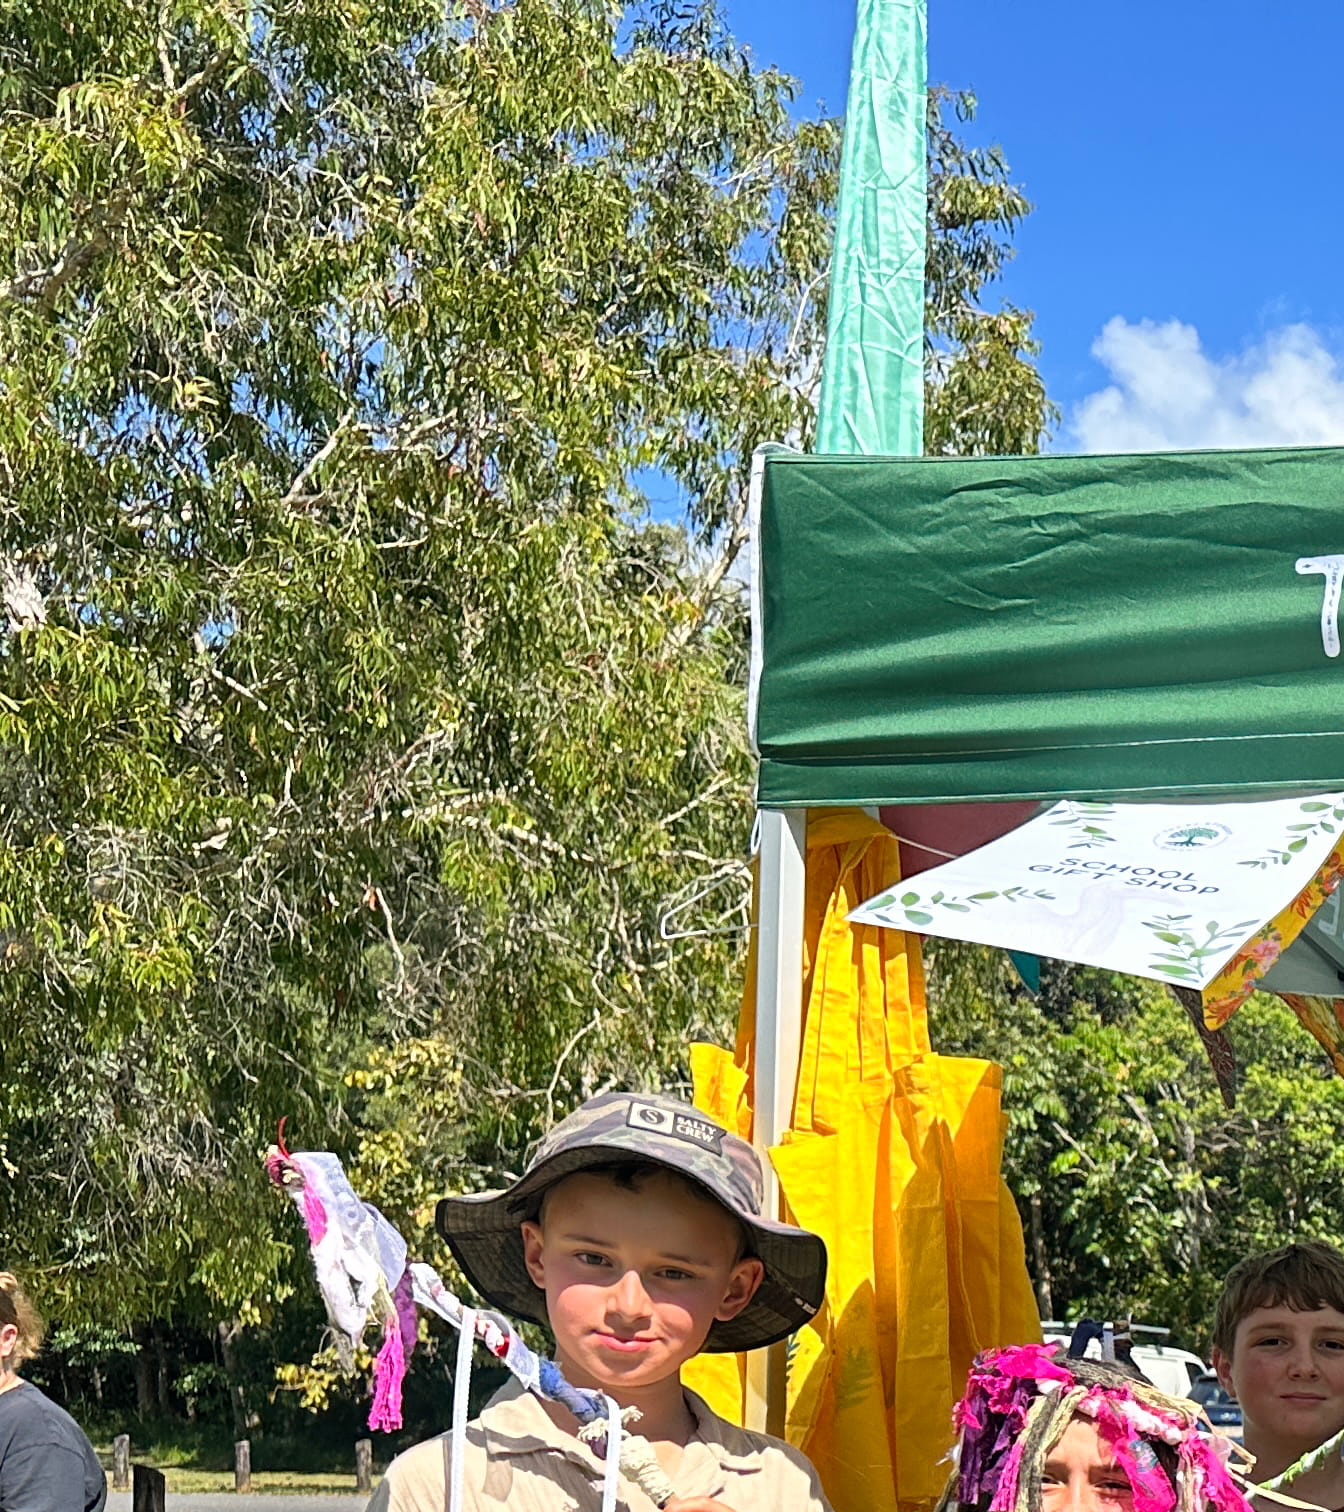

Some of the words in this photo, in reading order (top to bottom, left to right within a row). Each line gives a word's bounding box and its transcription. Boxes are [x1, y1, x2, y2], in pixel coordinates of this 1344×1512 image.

[1027, 864, 1116, 880] GIFT
[1124, 877, 1221, 895] SHOP
[1058, 857, 1198, 882] SCHOOL
[675, 1124, 714, 1143] CREW
[676, 1116, 717, 1134] SALTY
